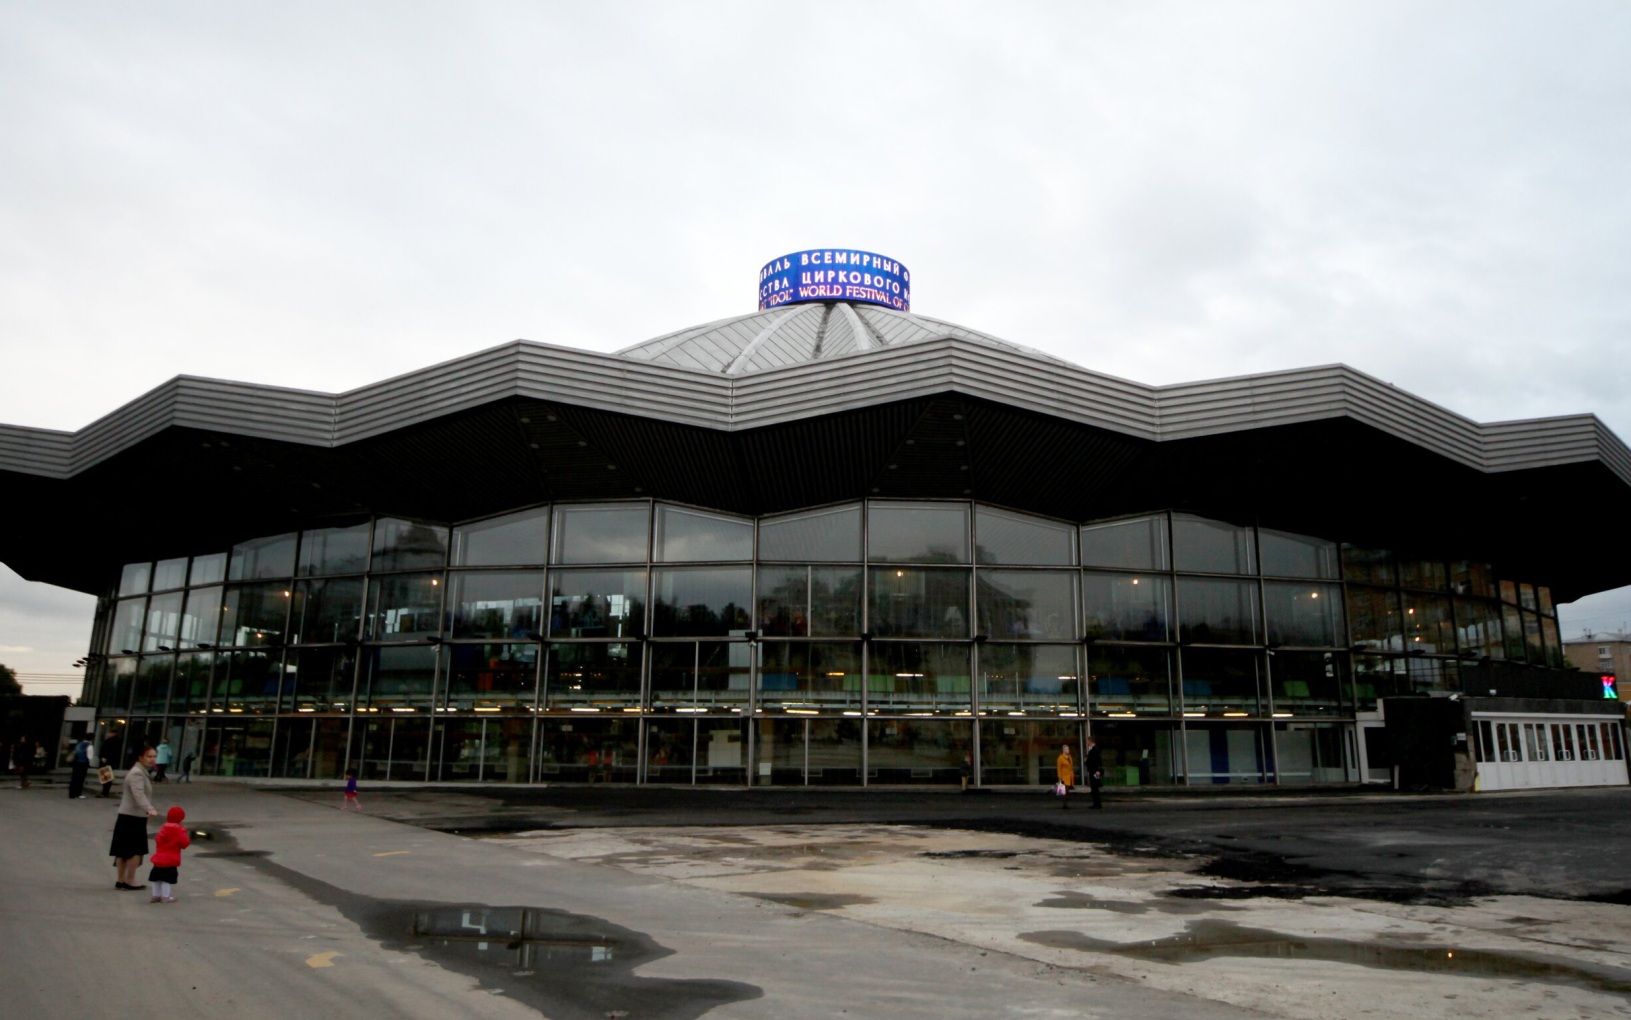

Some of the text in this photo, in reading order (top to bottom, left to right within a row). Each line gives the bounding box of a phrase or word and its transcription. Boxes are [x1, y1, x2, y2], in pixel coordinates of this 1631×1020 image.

[801, 251, 899, 276] ВСЕМИРНЫЙ
[802, 270, 900, 294] ЦИРКОВОГО
[799, 285, 842, 297] WORLD
[846, 286, 891, 304] FESTIVAL
[893, 296, 903, 309] OF
